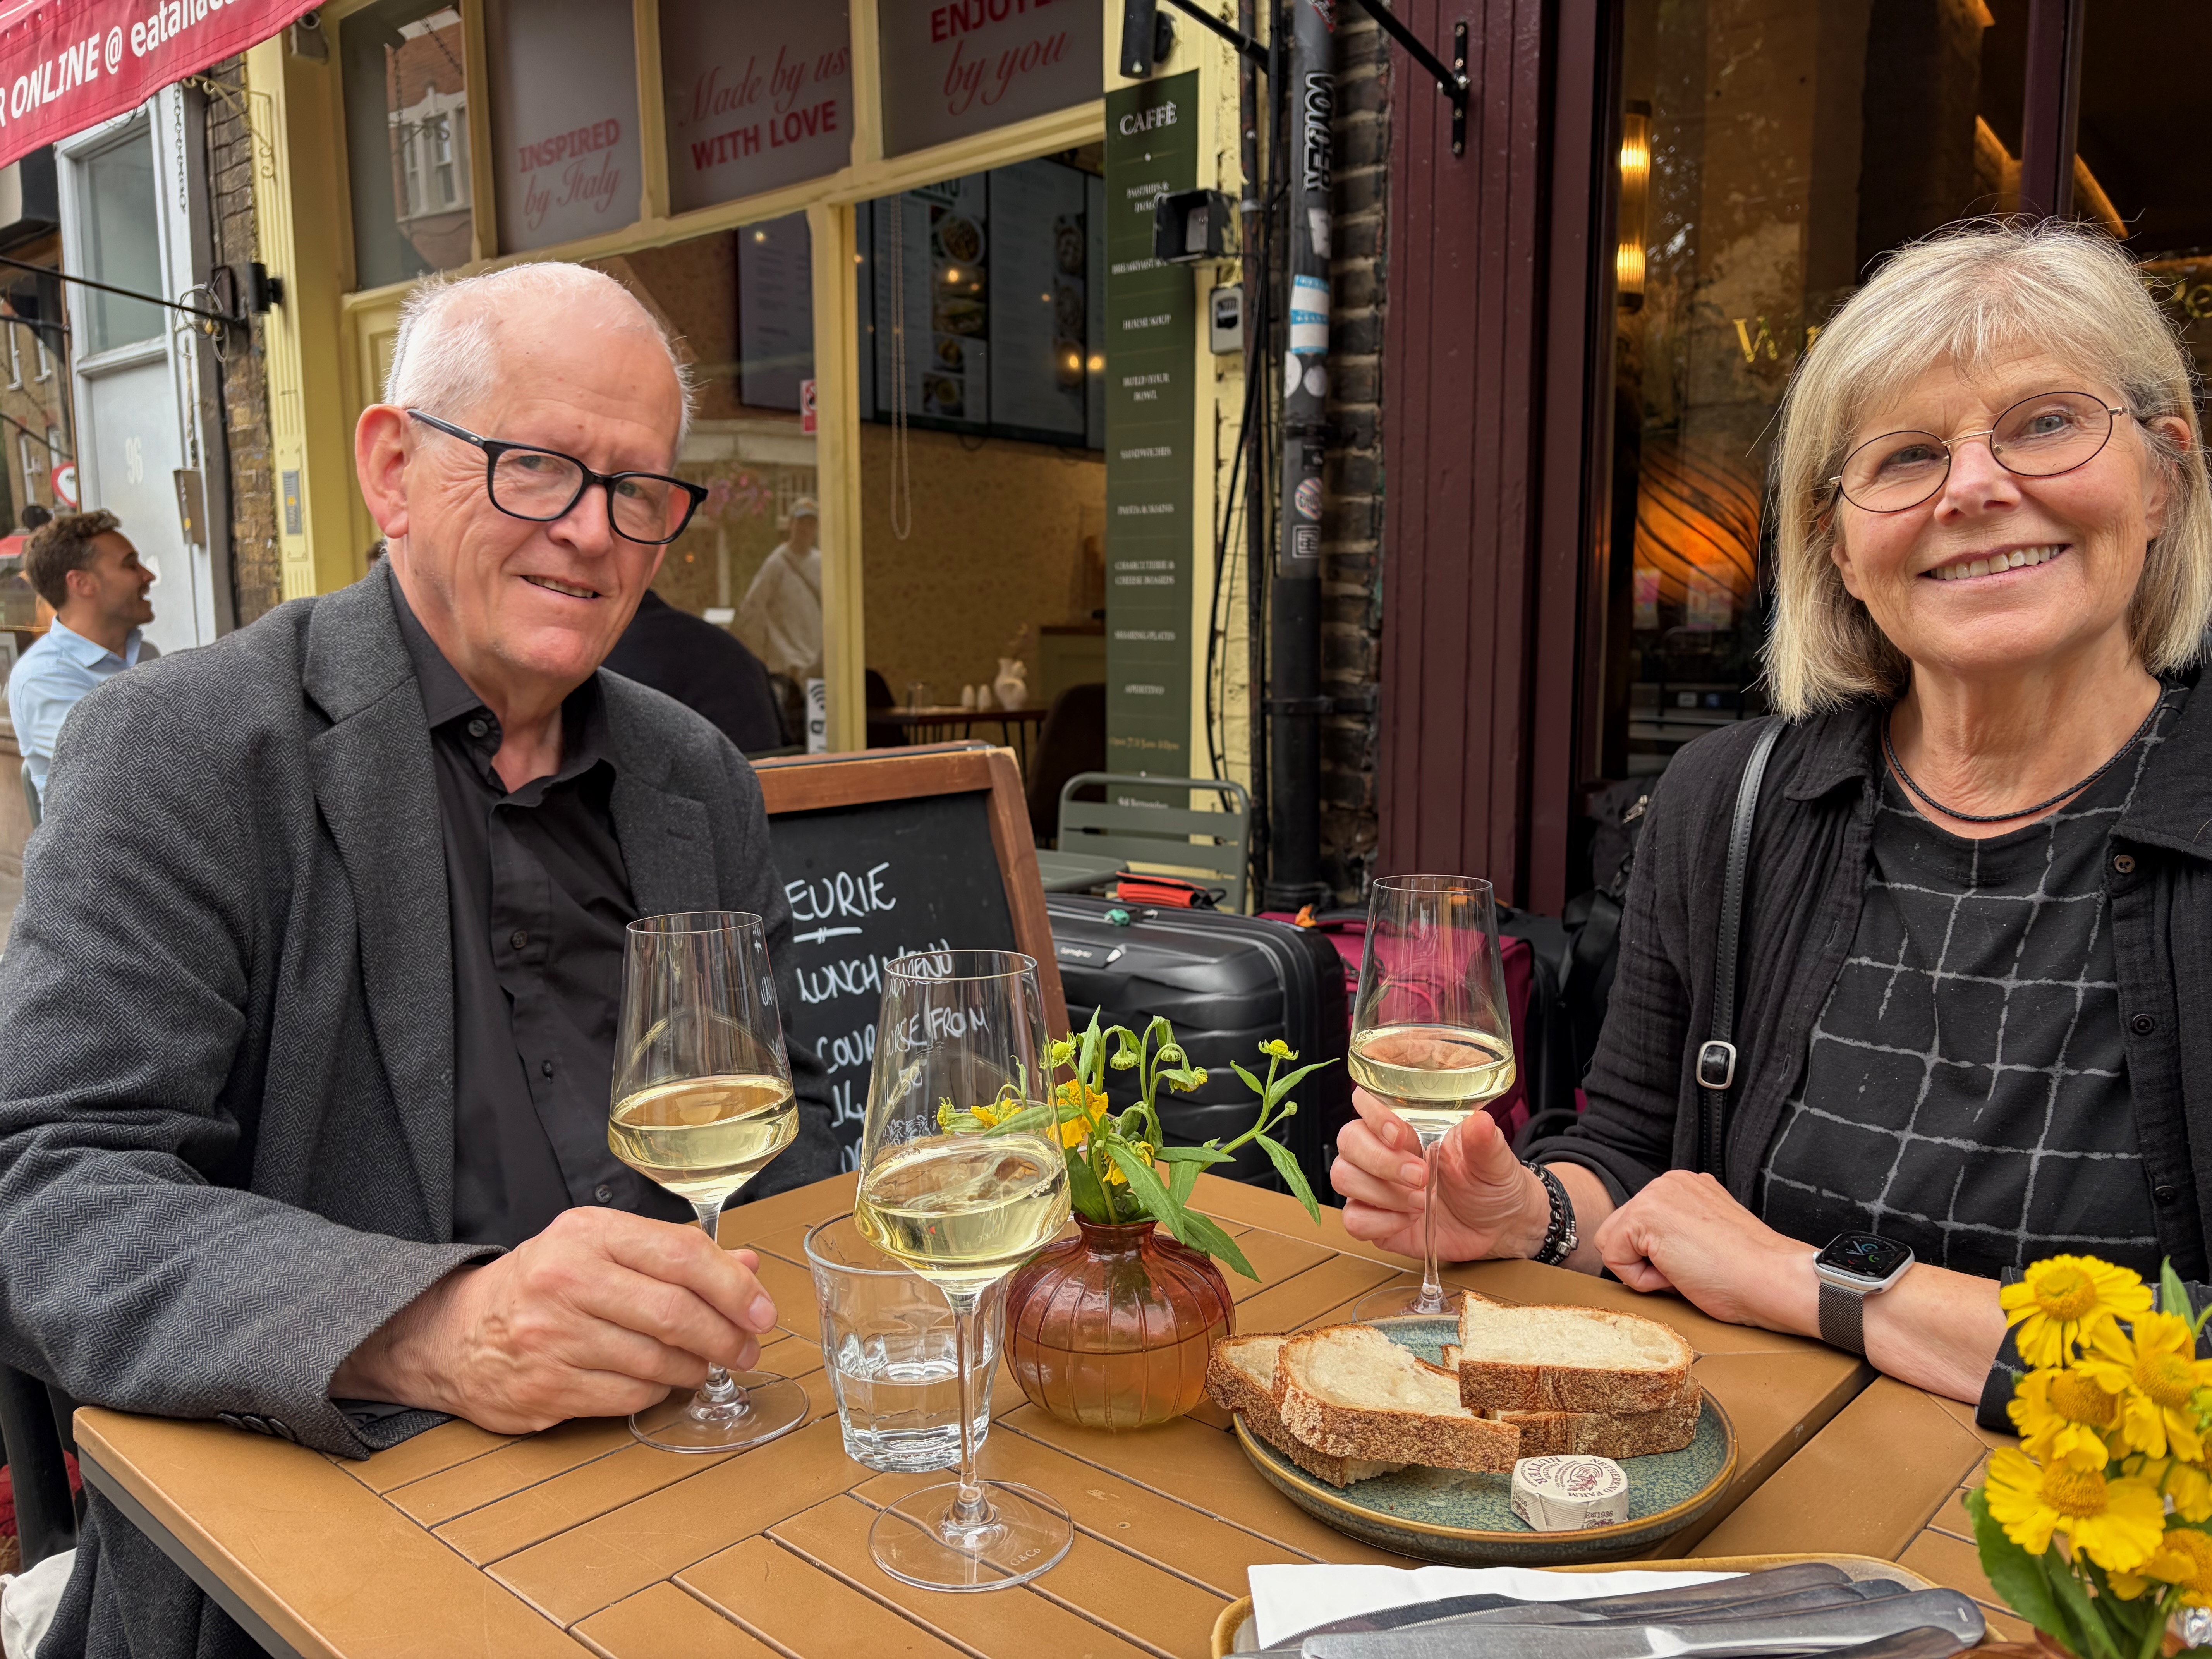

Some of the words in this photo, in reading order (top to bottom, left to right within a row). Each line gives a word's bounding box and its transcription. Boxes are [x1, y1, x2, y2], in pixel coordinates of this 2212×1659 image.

[931, 0, 1053, 43] ENJO
[11, 33, 100, 119] ONLINE
[105, 26, 122, 74] @
[678, 55, 763, 127] Made
[769, 45, 805, 115] by
[814, 46, 849, 82] us
[943, 40, 987, 116] by
[981, 32, 1073, 106] you
[519, 118, 622, 174] INSPIRED
[691, 124, 761, 170] WITH
[769, 100, 838, 148] LOVE
[524, 174, 551, 230] by
[556, 150, 621, 213] Italy
[784, 862, 897, 921] EURIE
[797, 954, 882, 1004] LUNCH
[930, 1006, 990, 1041] FROM
[1528, 1457, 1563, 1485] BUTTER
[1589, 1458, 1621, 1493] NETHEREND
